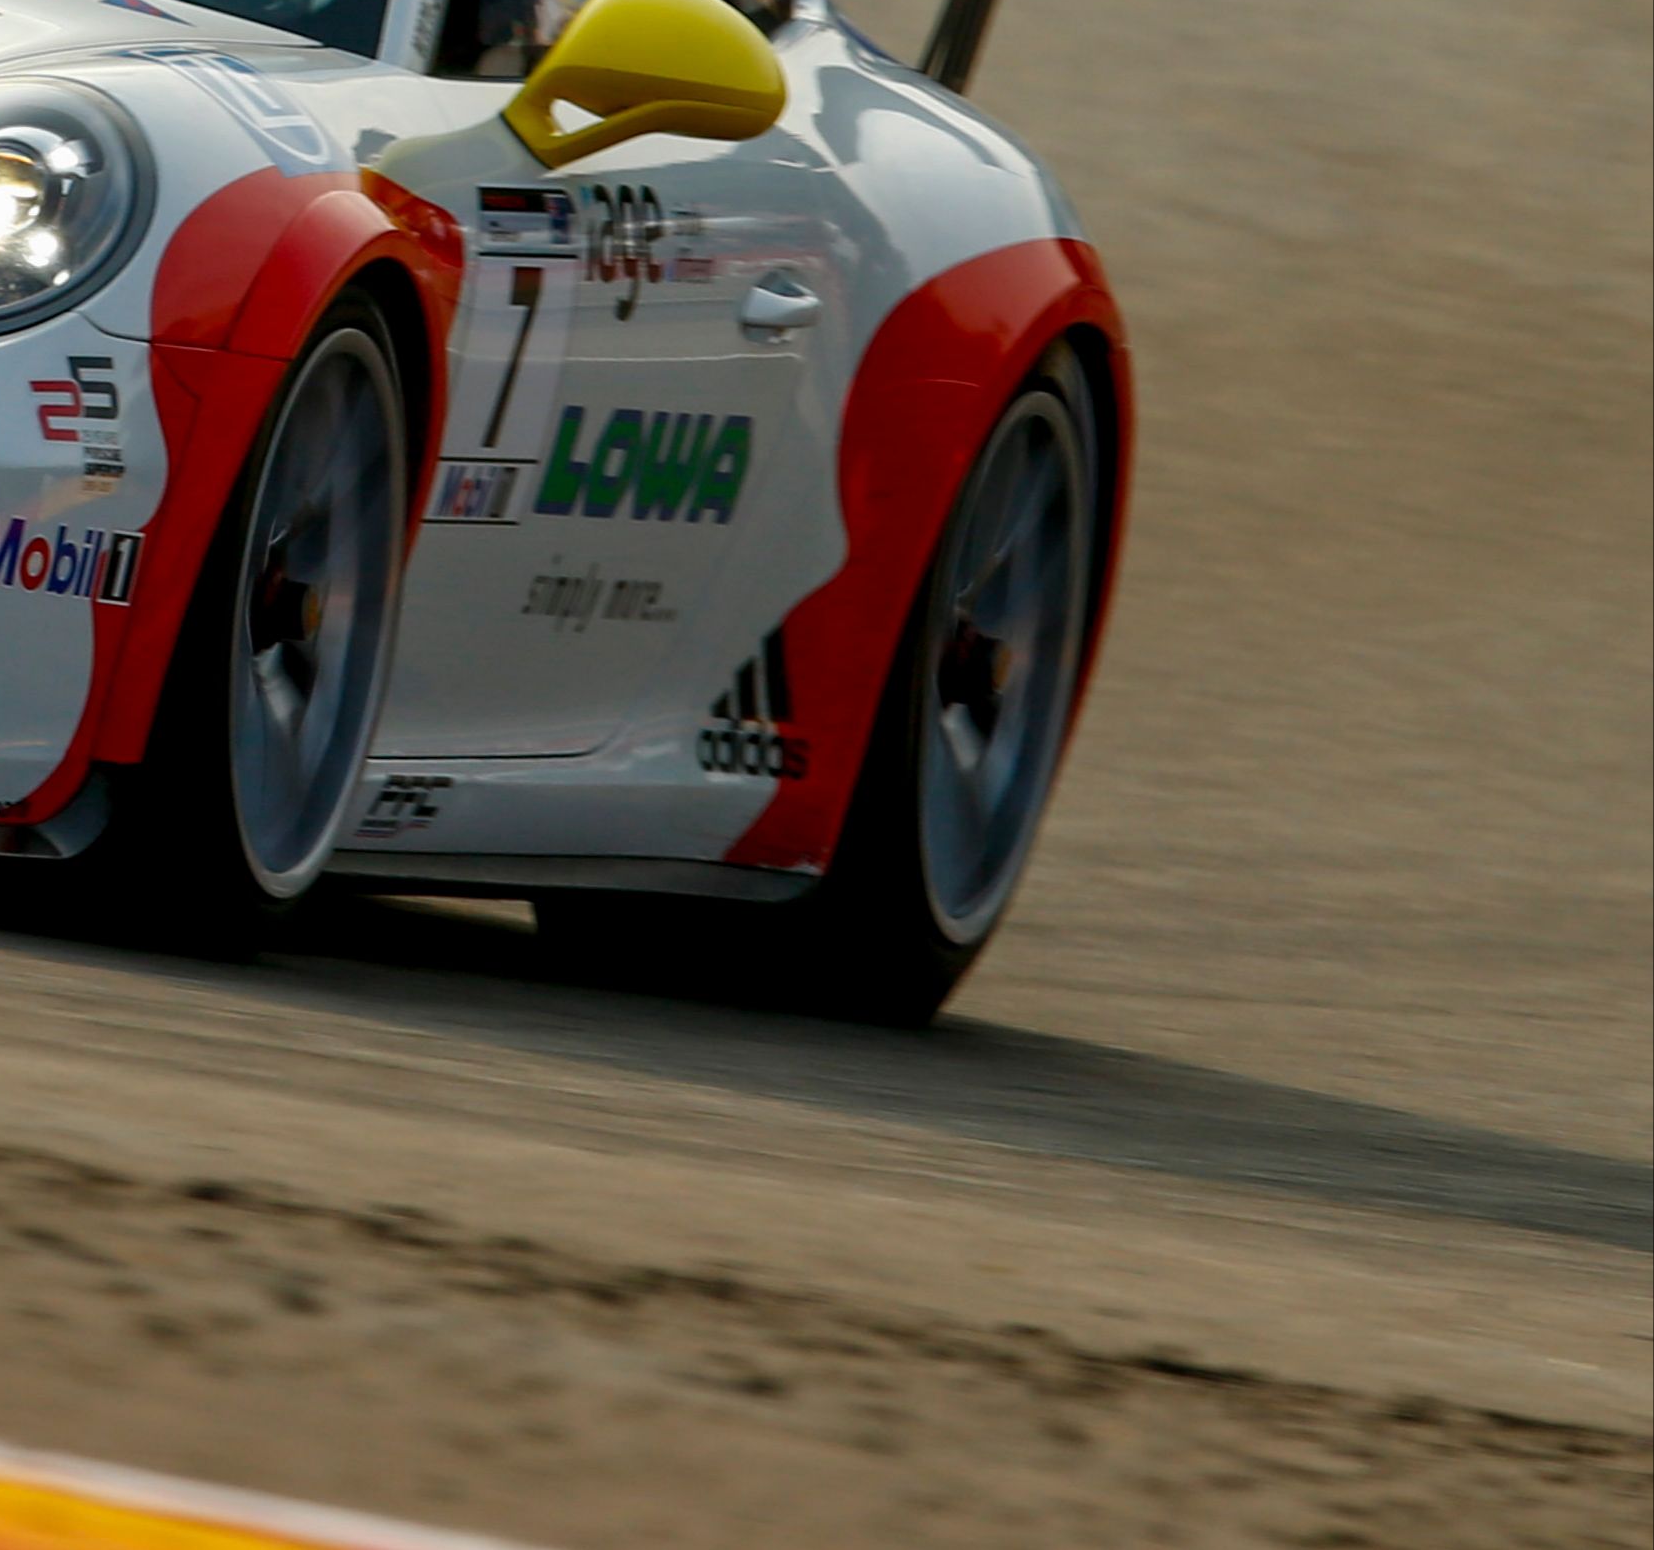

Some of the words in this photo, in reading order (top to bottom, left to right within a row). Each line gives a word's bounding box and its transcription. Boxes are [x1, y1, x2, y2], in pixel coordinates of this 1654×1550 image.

[28, 356, 120, 442] 25
[482, 266, 545, 448] 7
[533, 405, 755, 524] LOWA
[696, 728, 810, 779] adidas
